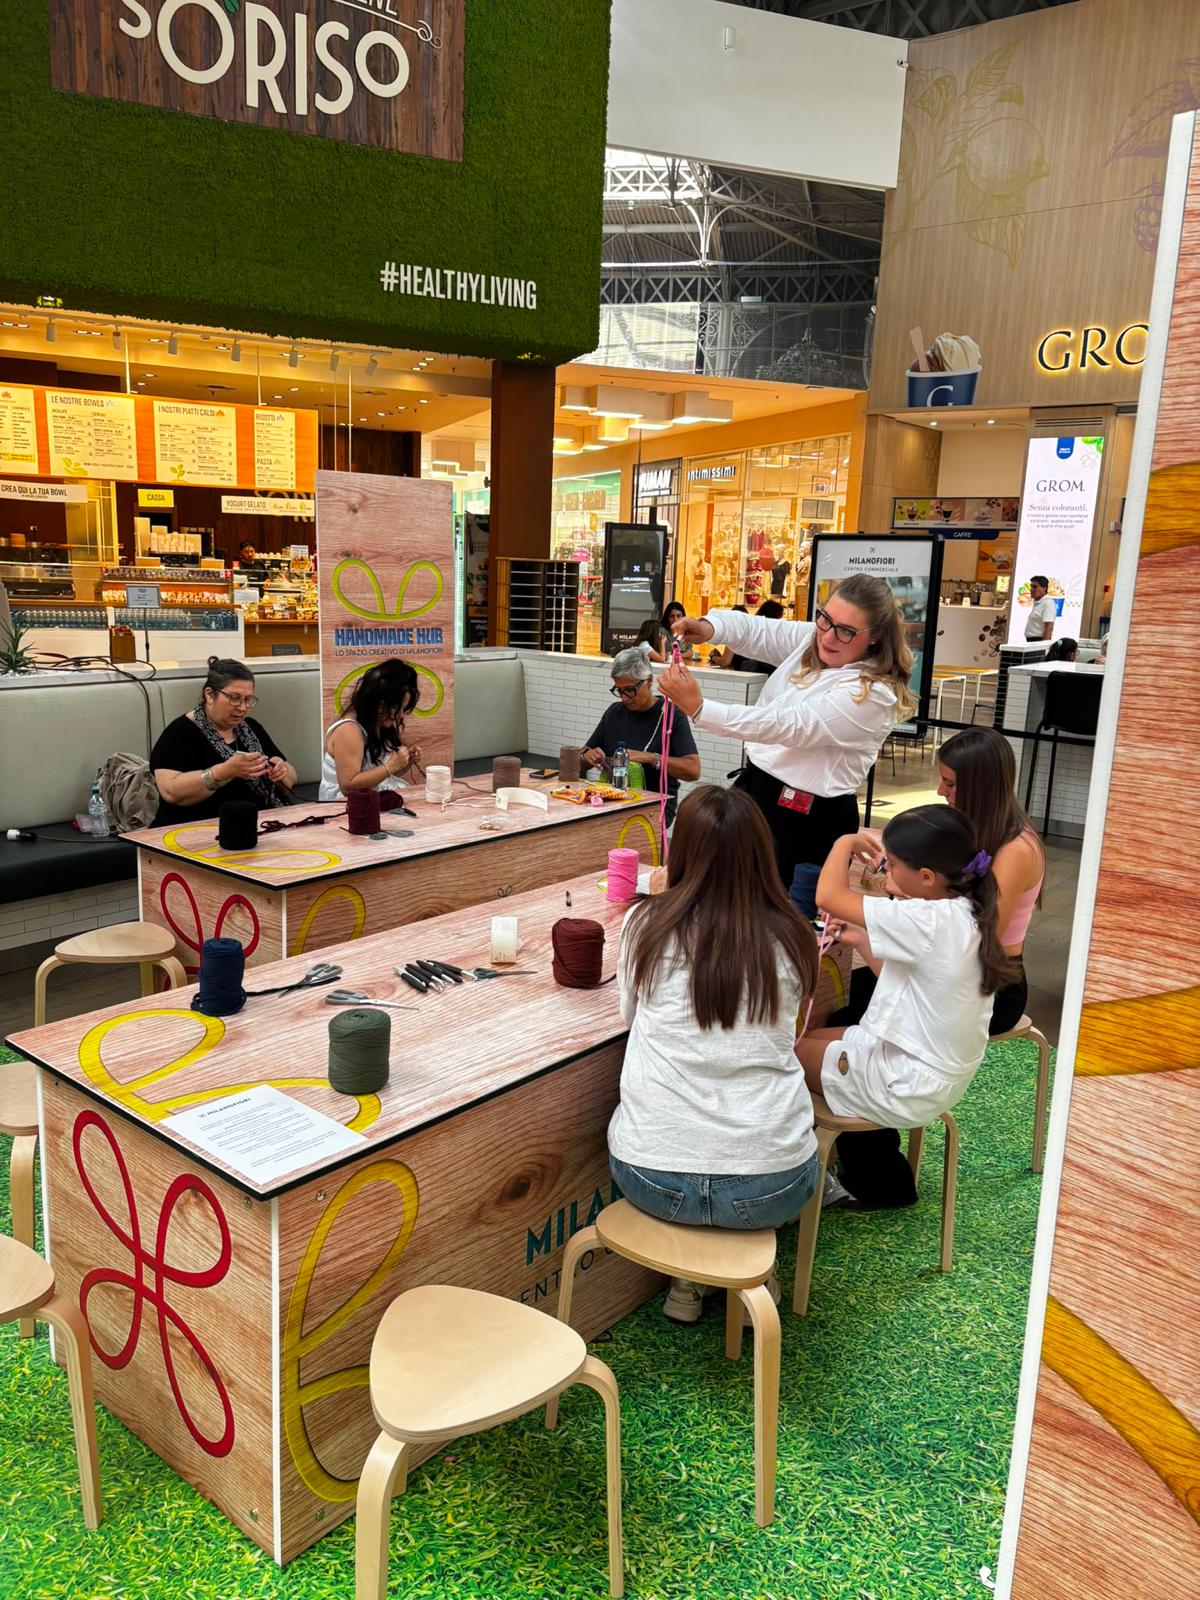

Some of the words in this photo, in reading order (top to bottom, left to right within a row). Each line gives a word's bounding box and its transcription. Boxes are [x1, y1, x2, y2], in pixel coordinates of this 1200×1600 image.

[380, 261, 537, 310] #HEALTHYLIVING
[1038, 324, 1149, 371] GRO
[51, 395, 58, 404] LE
[60, 396, 82, 406] NOSTRE
[84, 398, 104, 407] BOWLS
[162, 406, 181, 414] NOSTRI
[183, 407, 199, 416] PIATTI
[200, 409, 216, 417] CALDI
[256, 413, 275, 422] RISOTTI
[257, 458, 272, 466] PASTA
[688, 466, 735, 480] intimissimi
[1, 484, 17, 494] CREA
[18, 486, 28, 494] QUI
[29, 487, 37, 495] LA
[38, 488, 49, 496] TUA
[51, 488, 67, 497] BOWL
[147, 494, 165, 502] CASSA
[226, 500, 246, 508] YOGURT
[248, 501, 266, 509] GELATO
[1029, 504, 1050, 512] Senza
[849, 557, 895, 565] MILANOFIORI
[335, 628, 413, 646] HANDMADE
[416, 627, 443, 645] HUB
[369, 648, 398, 656] CREATIVO
[407, 647, 444, 655] MILANOFIORI
